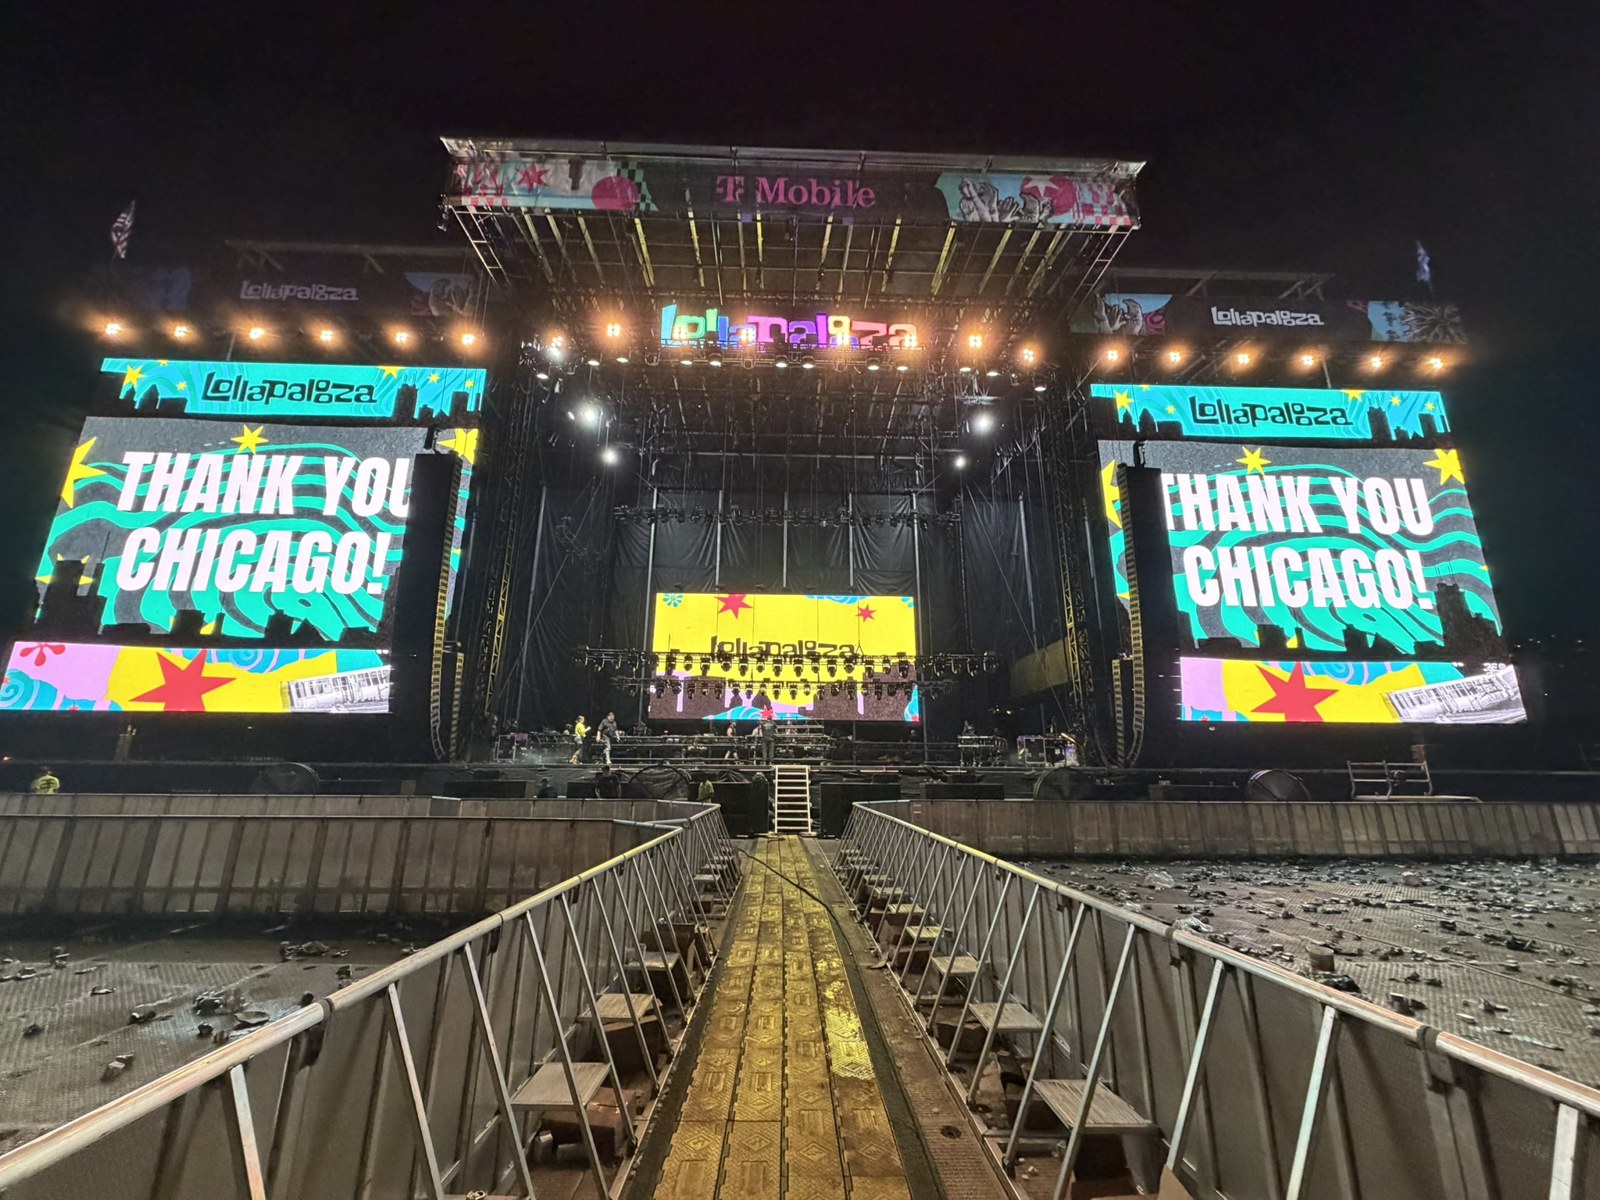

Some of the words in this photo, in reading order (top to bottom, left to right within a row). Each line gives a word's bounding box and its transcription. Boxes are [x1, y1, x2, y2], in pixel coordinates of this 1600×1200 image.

[716, 175, 745, 203] T
[757, 175, 876, 208] Mobile
[240, 280, 359, 302] Lollapalooza
[1210, 306, 1325, 327] Lollapalooza
[202, 370, 379, 405] Lollapalooza
[1188, 395, 1354, 428] Lollapalooza
[116, 451, 299, 515] THANK
[1328, 475, 1435, 537] YOU
[115, 525, 393, 595] CHICAGO!
[1182, 545, 1434, 610] CHICAGO!
